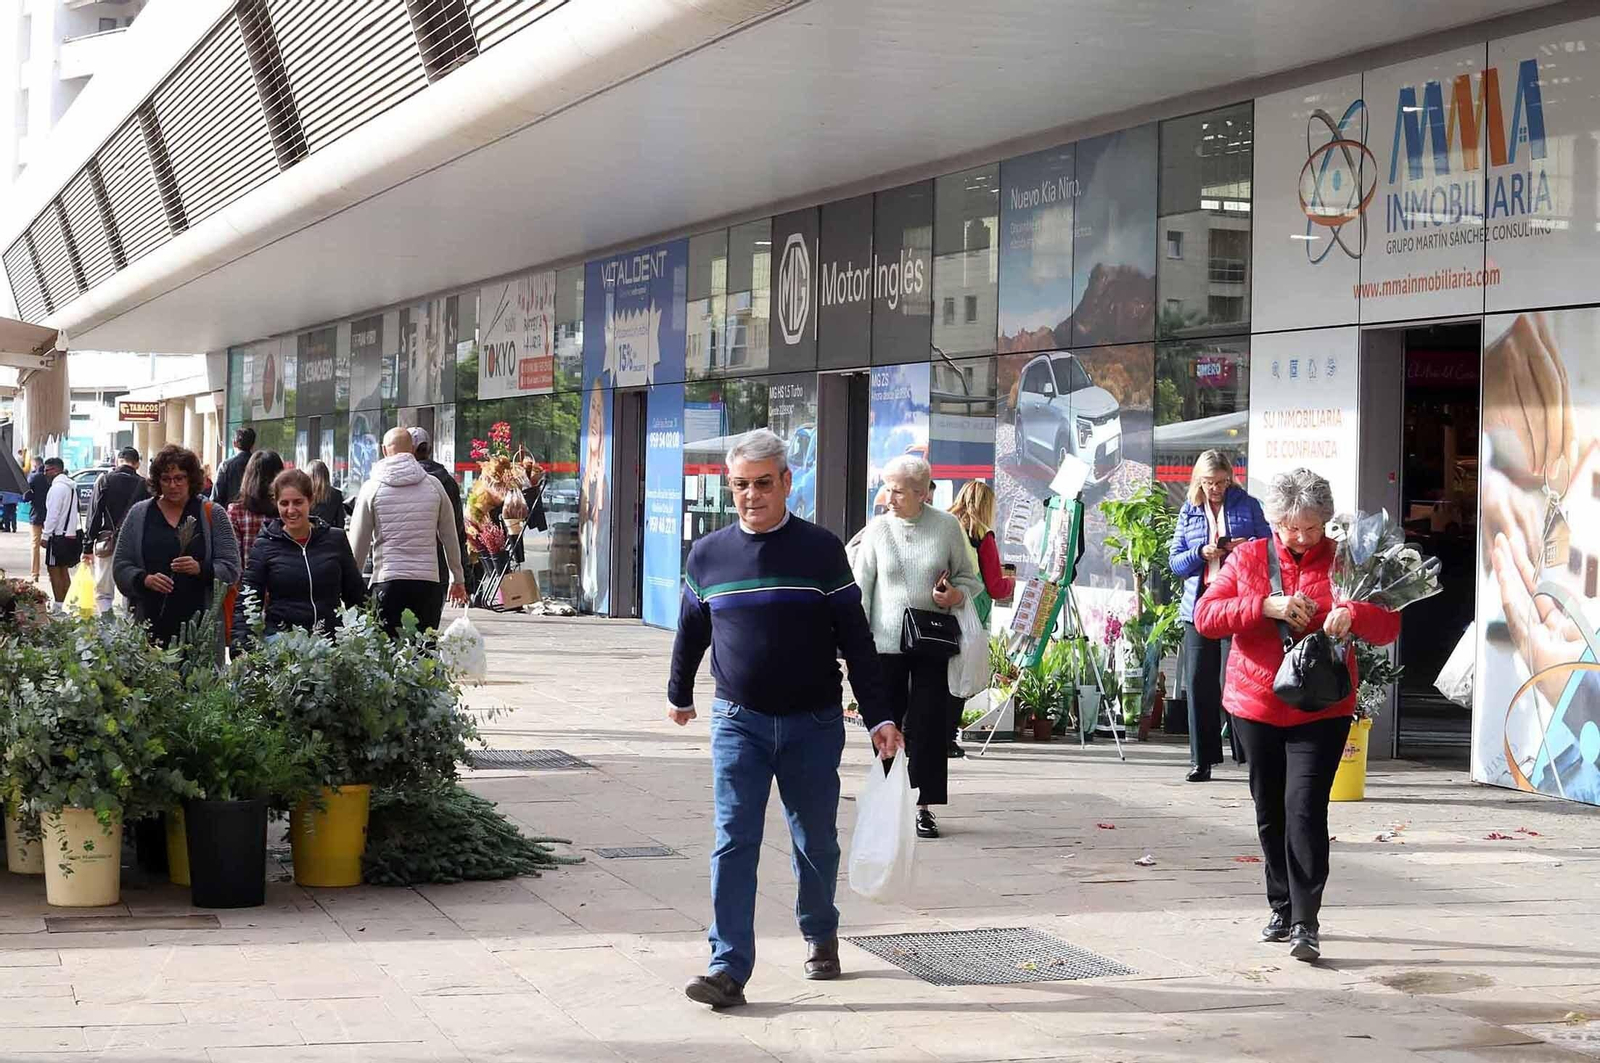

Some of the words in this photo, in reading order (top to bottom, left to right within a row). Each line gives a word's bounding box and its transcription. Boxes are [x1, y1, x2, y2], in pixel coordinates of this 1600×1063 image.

[1389, 59, 1548, 184] MMA
[1010, 186, 1040, 211] Nuevo
[1042, 180, 1056, 203] Kia
[1059, 176, 1082, 199] Niro.
[1386, 169, 1552, 233] INMOBILIARIA
[1386, 238, 1414, 254] GRUPO
[1416, 229, 1447, 251] MARTÍN
[1450, 226, 1490, 247] SÁNCHEZ
[1493, 221, 1552, 241] CONSULTING
[601, 250, 668, 289] VITALDENT
[822, 260, 870, 306] Motor
[874, 247, 924, 310] Inglés
[1353, 267, 1501, 299] www.mmainmobiliaria.com
[483, 340, 516, 378] TOKYO
[129, 403, 159, 412] TABACOS
[1264, 410, 1276, 428] SU
[1278, 408, 1342, 428] INMOBILIARIA
[1266, 440, 1278, 458] DE
[1282, 440, 1338, 458] CONFIANZA
